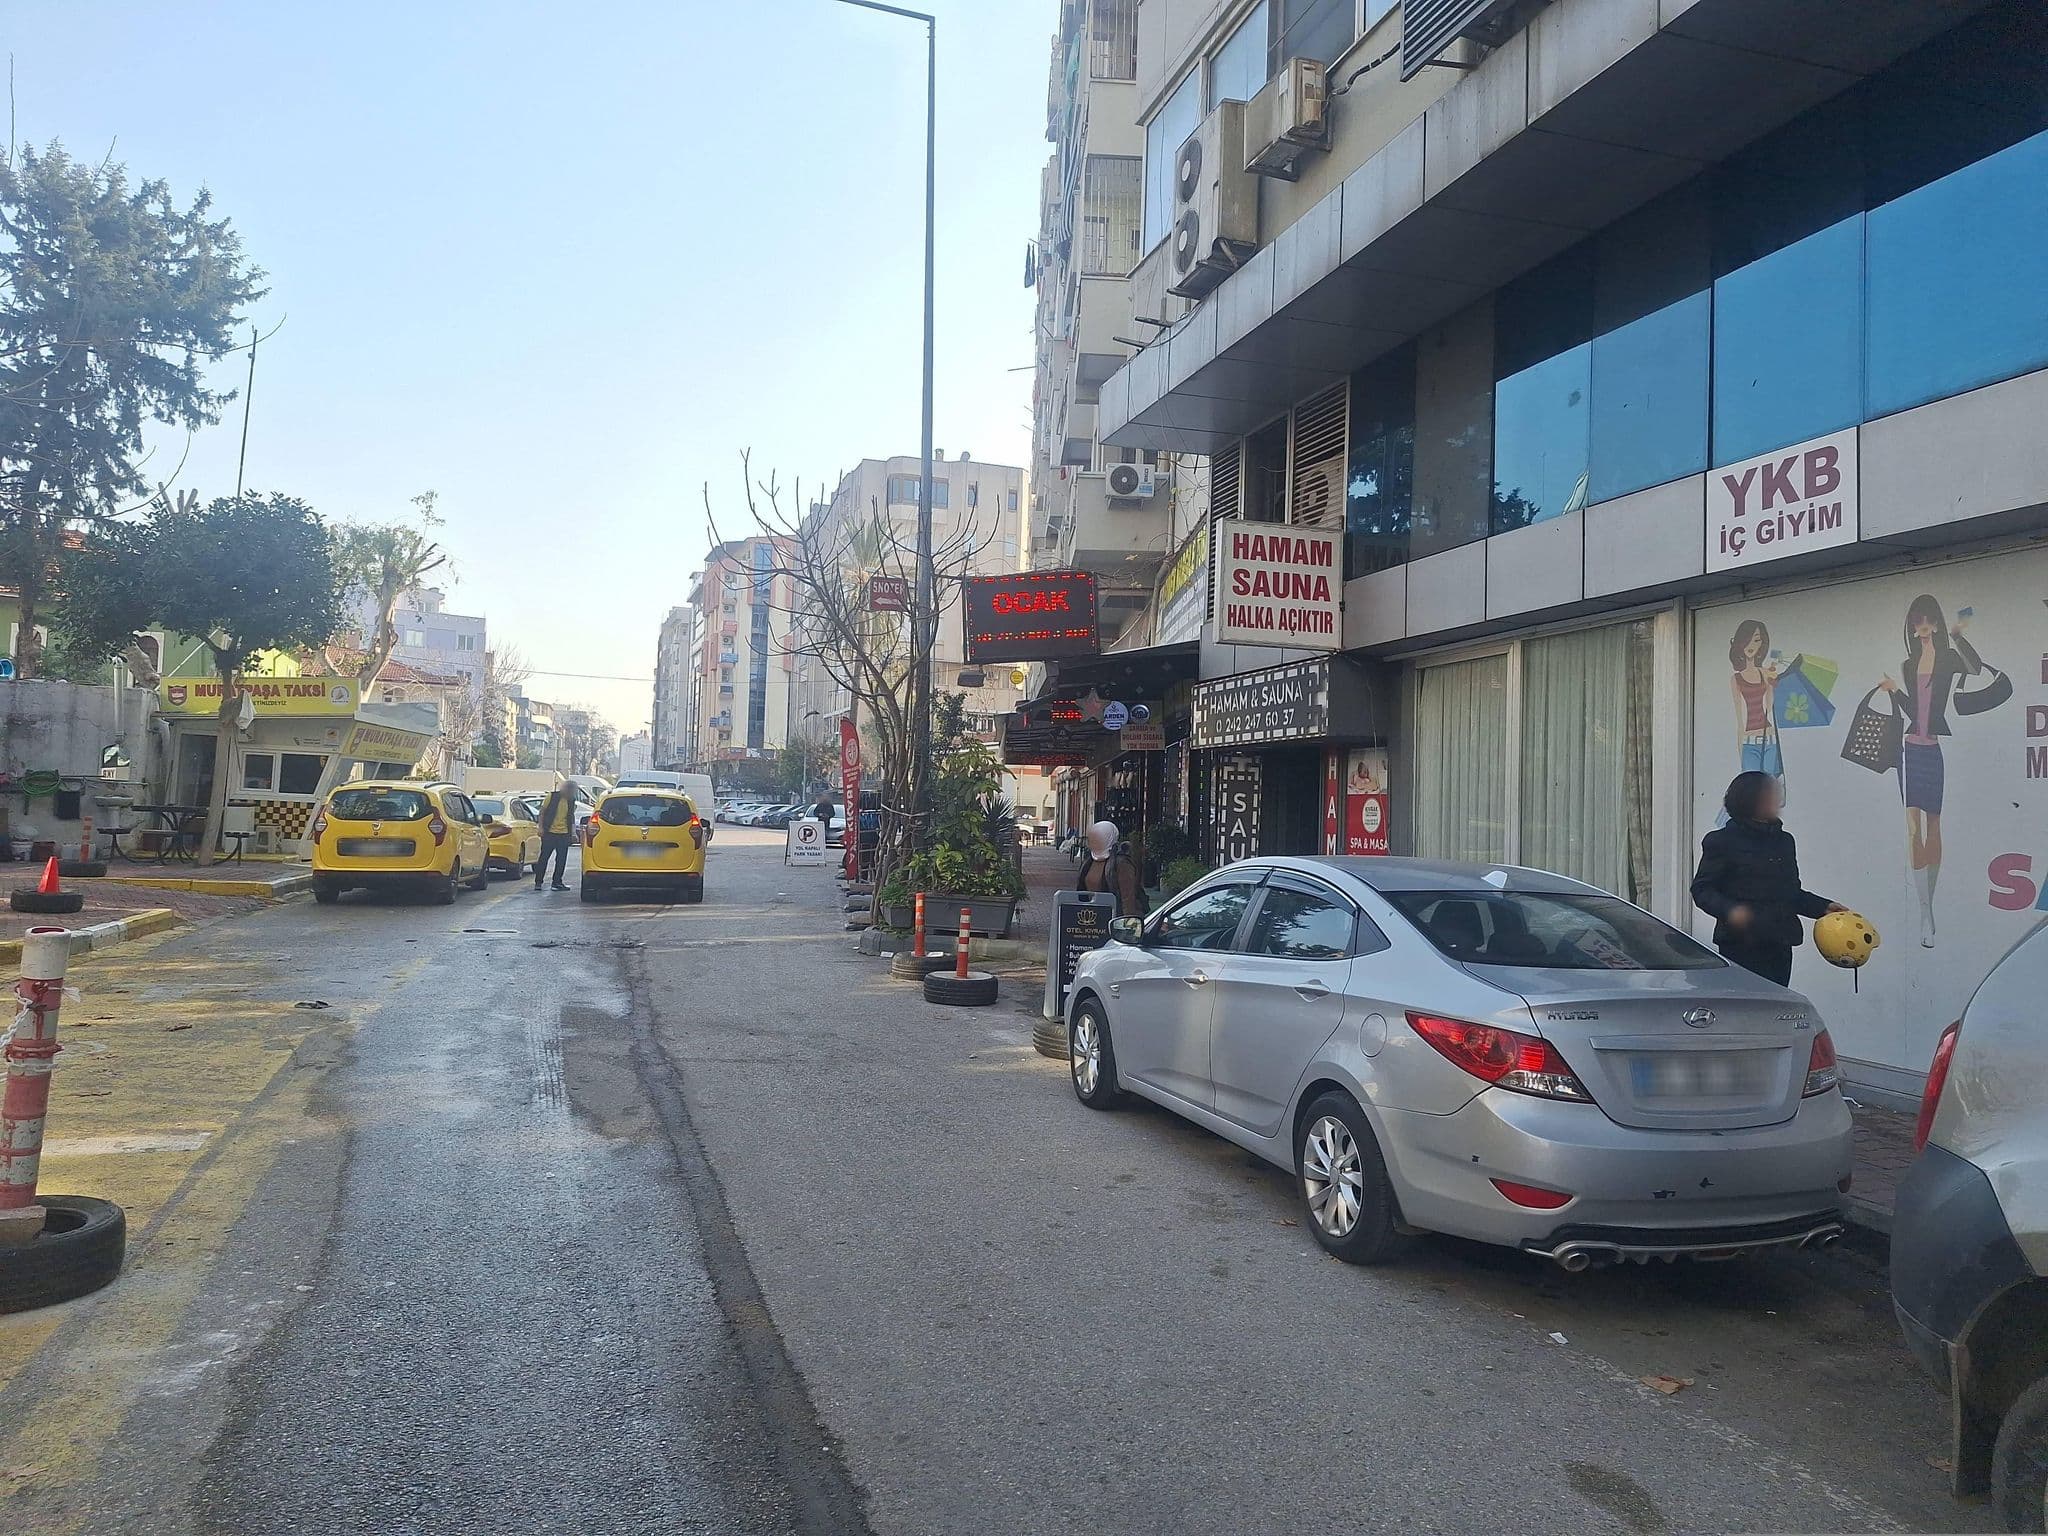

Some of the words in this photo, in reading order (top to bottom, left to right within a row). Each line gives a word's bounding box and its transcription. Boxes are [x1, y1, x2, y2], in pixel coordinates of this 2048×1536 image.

[1721, 445, 1841, 518] YKB
[1720, 525, 1746, 557] İÇ
[1755, 502, 1842, 545] GİYİM
[1232, 533, 1332, 567] HAMAM
[1232, 568, 1331, 602] SAUNA
[992, 590, 1070, 614] OCAK
[1227, 604, 1274, 630] HALKA
[283, 682, 326, 697] TAKSİ
[1210, 692, 1248, 715] HAMAM
[1251, 689, 1259, 705] &
[1262, 681, 1303, 706] SAUNA
[1225, 714, 1241, 732] 242
[1245, 713, 1261, 730] 247
[1265, 711, 1279, 727] 60
[1283, 708, 1294, 725] 37
[1350, 837, 1363, 849] SPA
[1364, 838, 1368, 849] &
[1547, 1010, 1599, 1020] HYUNDAI
